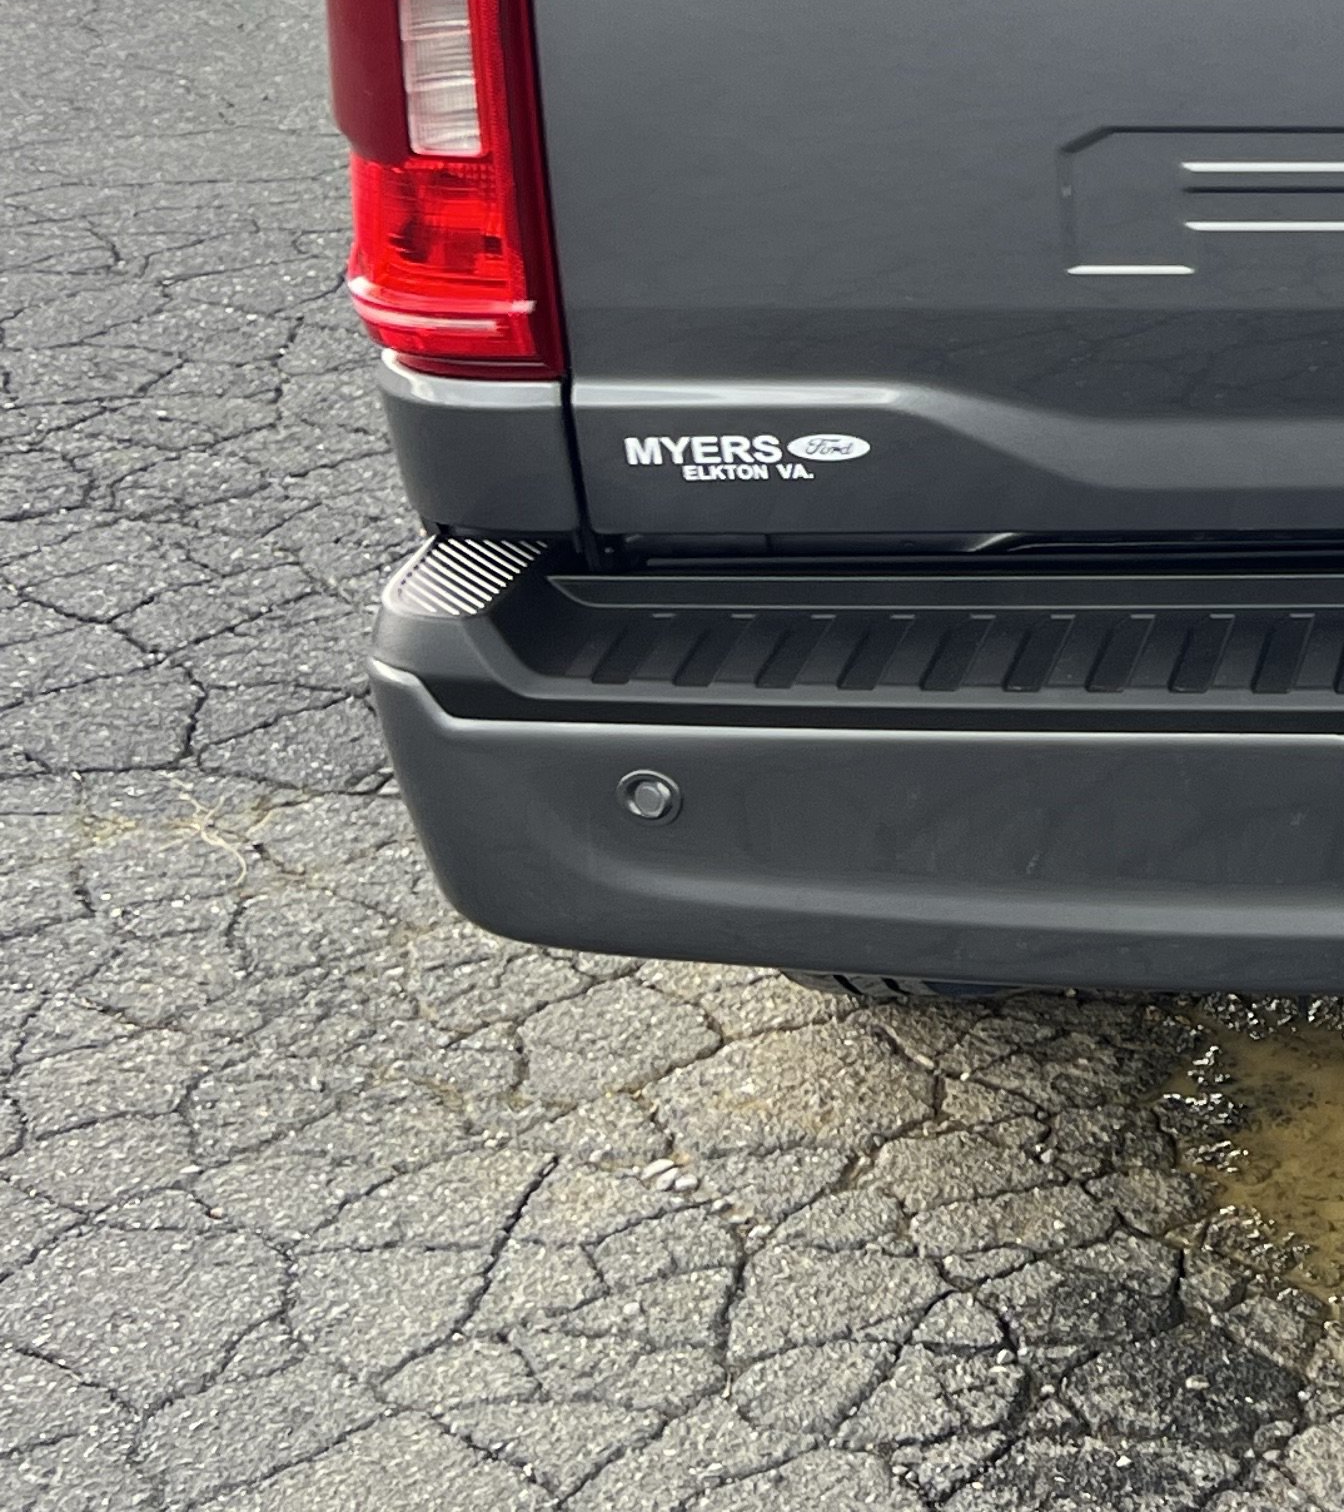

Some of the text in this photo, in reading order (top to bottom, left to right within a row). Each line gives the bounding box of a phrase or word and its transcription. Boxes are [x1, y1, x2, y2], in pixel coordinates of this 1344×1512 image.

[623, 435, 783, 465] MYERS
[682, 463, 815, 481] ELKTON VA.
